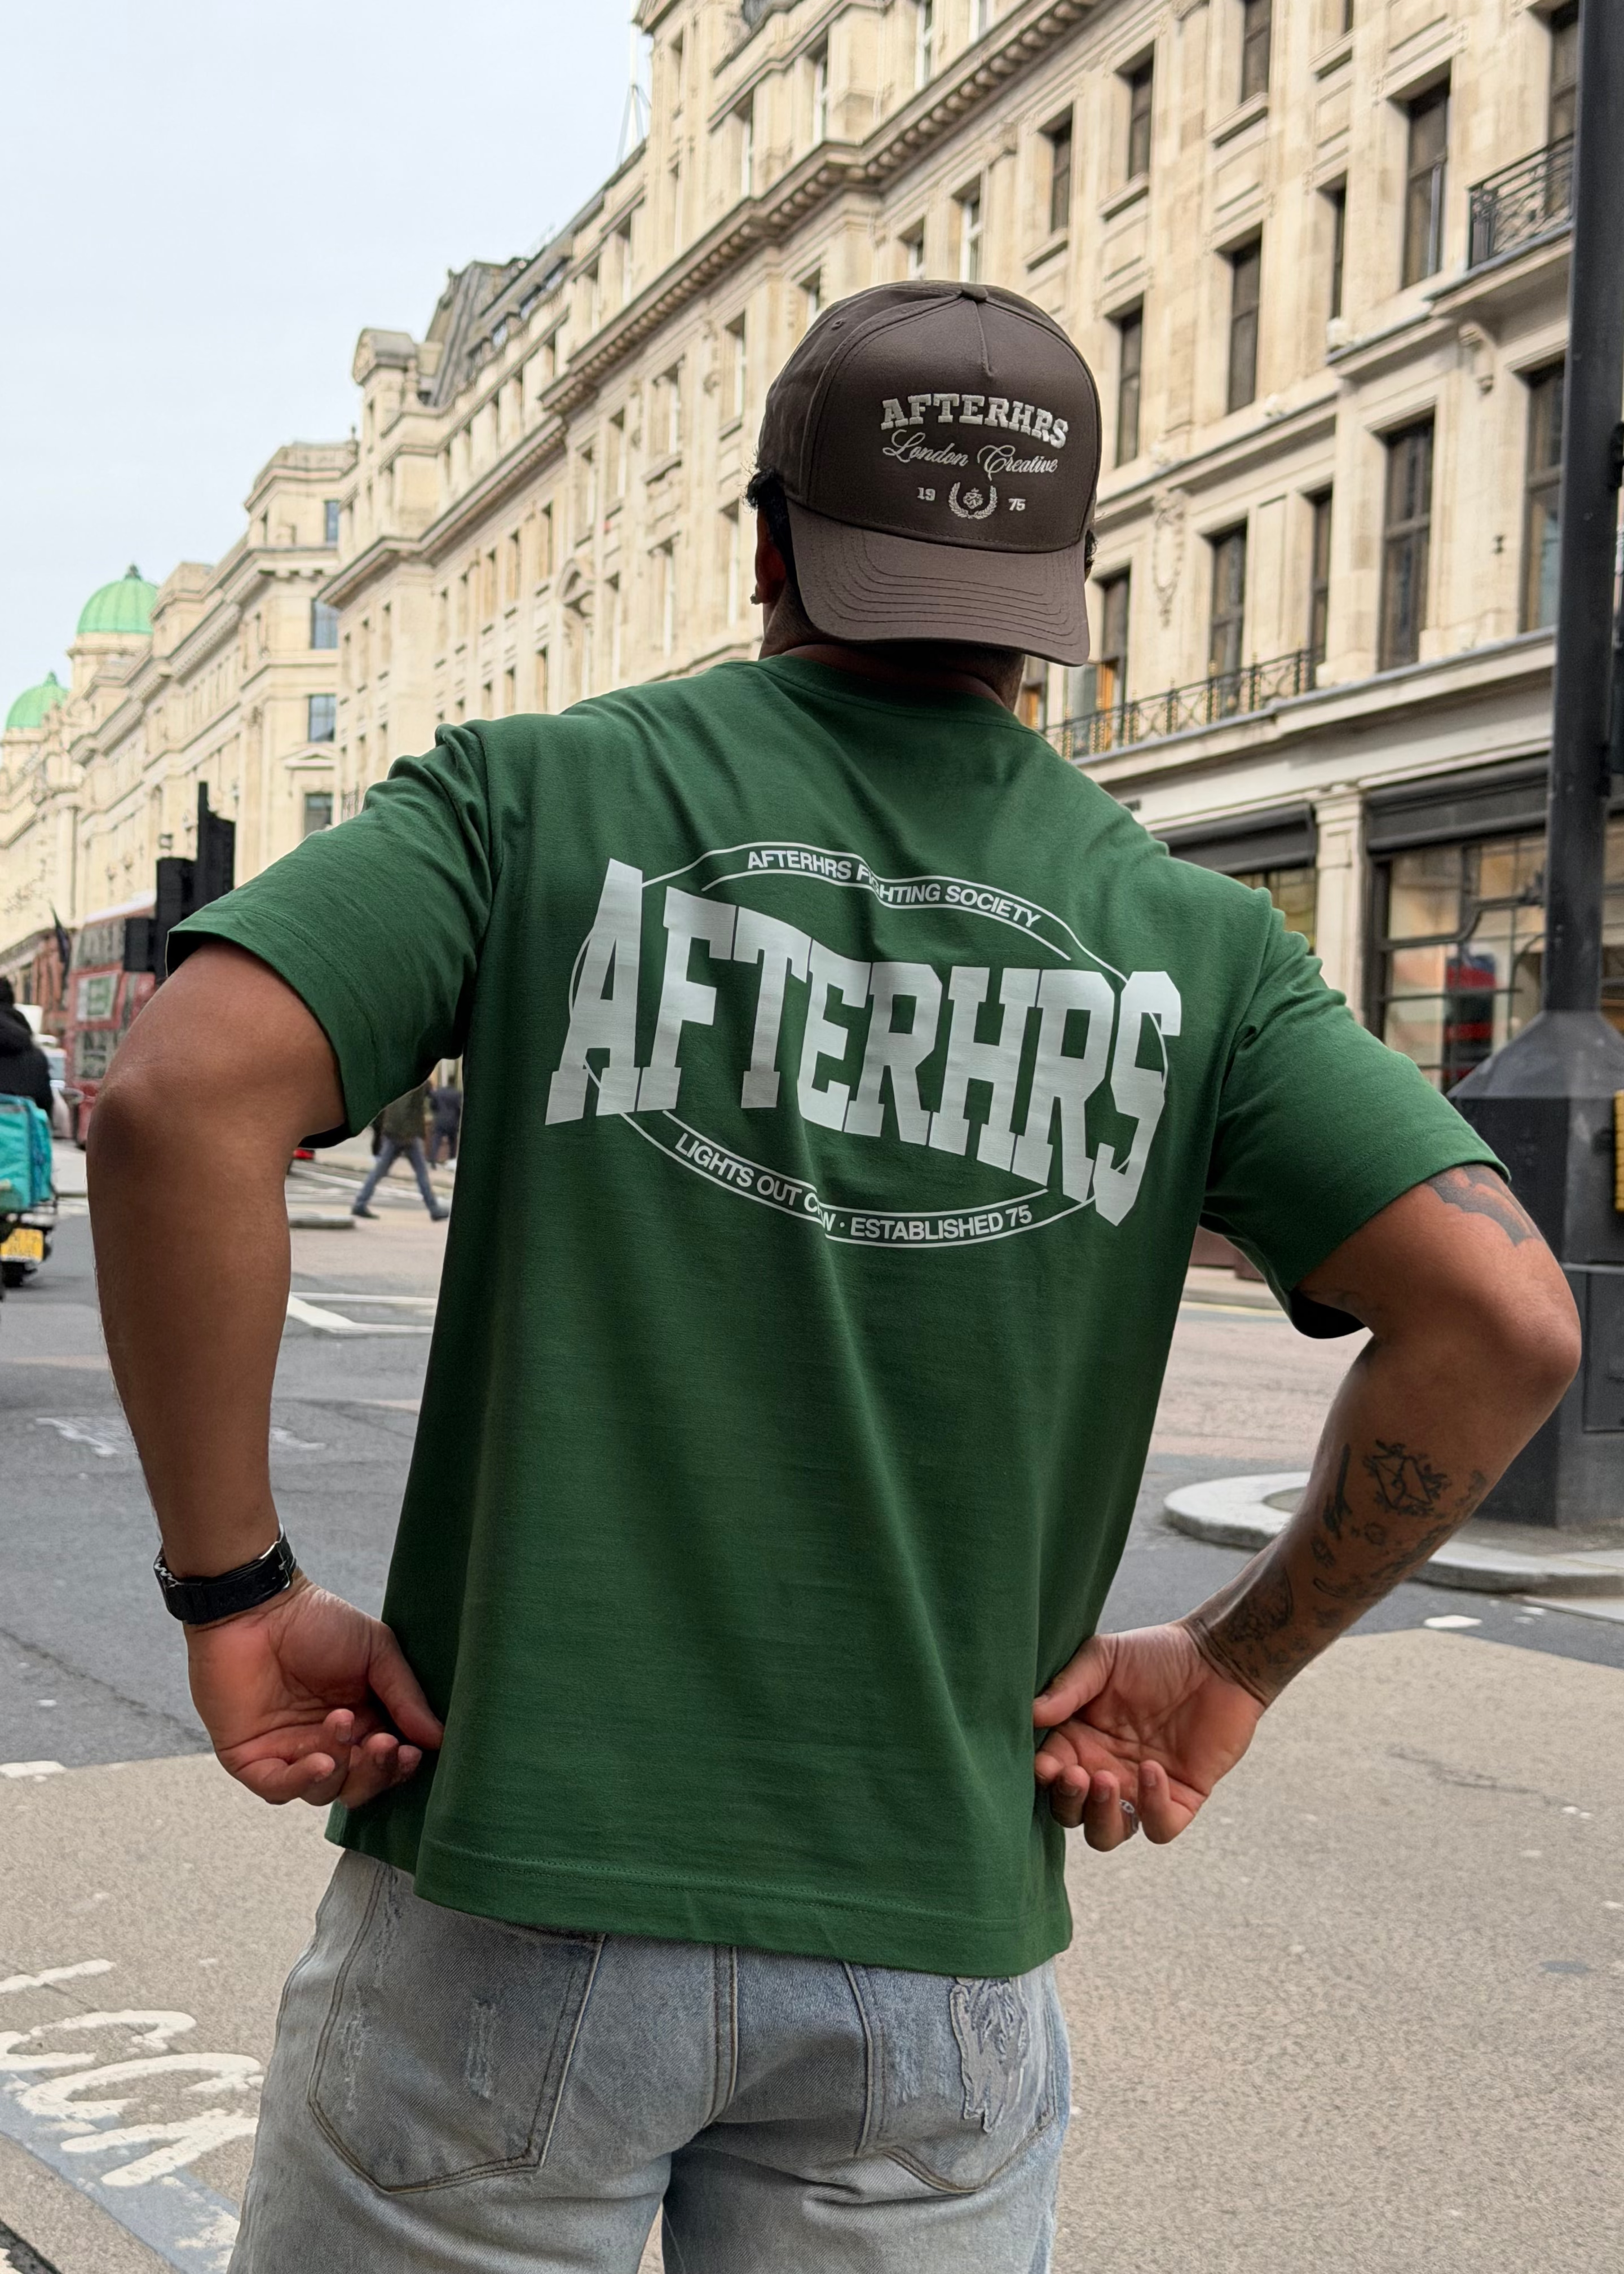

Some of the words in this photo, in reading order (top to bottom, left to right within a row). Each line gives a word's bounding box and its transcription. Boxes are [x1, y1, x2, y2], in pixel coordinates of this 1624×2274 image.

[881, 393, 1069, 449] AFTERHRS
[882, 429, 969, 466] London
[977, 444, 1058, 481] Creative
[917, 487, 936, 501] 19
[1008, 498, 1026, 511] 75
[747, 850, 852, 880] AFTERHRS
[945, 885, 1041, 928] SOCIETY
[545, 857, 1182, 1227] AFTERHRS
[674, 1132, 754, 1187] LIGHTS
[757, 1175, 802, 1206] OUT
[850, 1211, 1004, 1240] ESTABLISHED
[1005, 1204, 1032, 1227] 75
